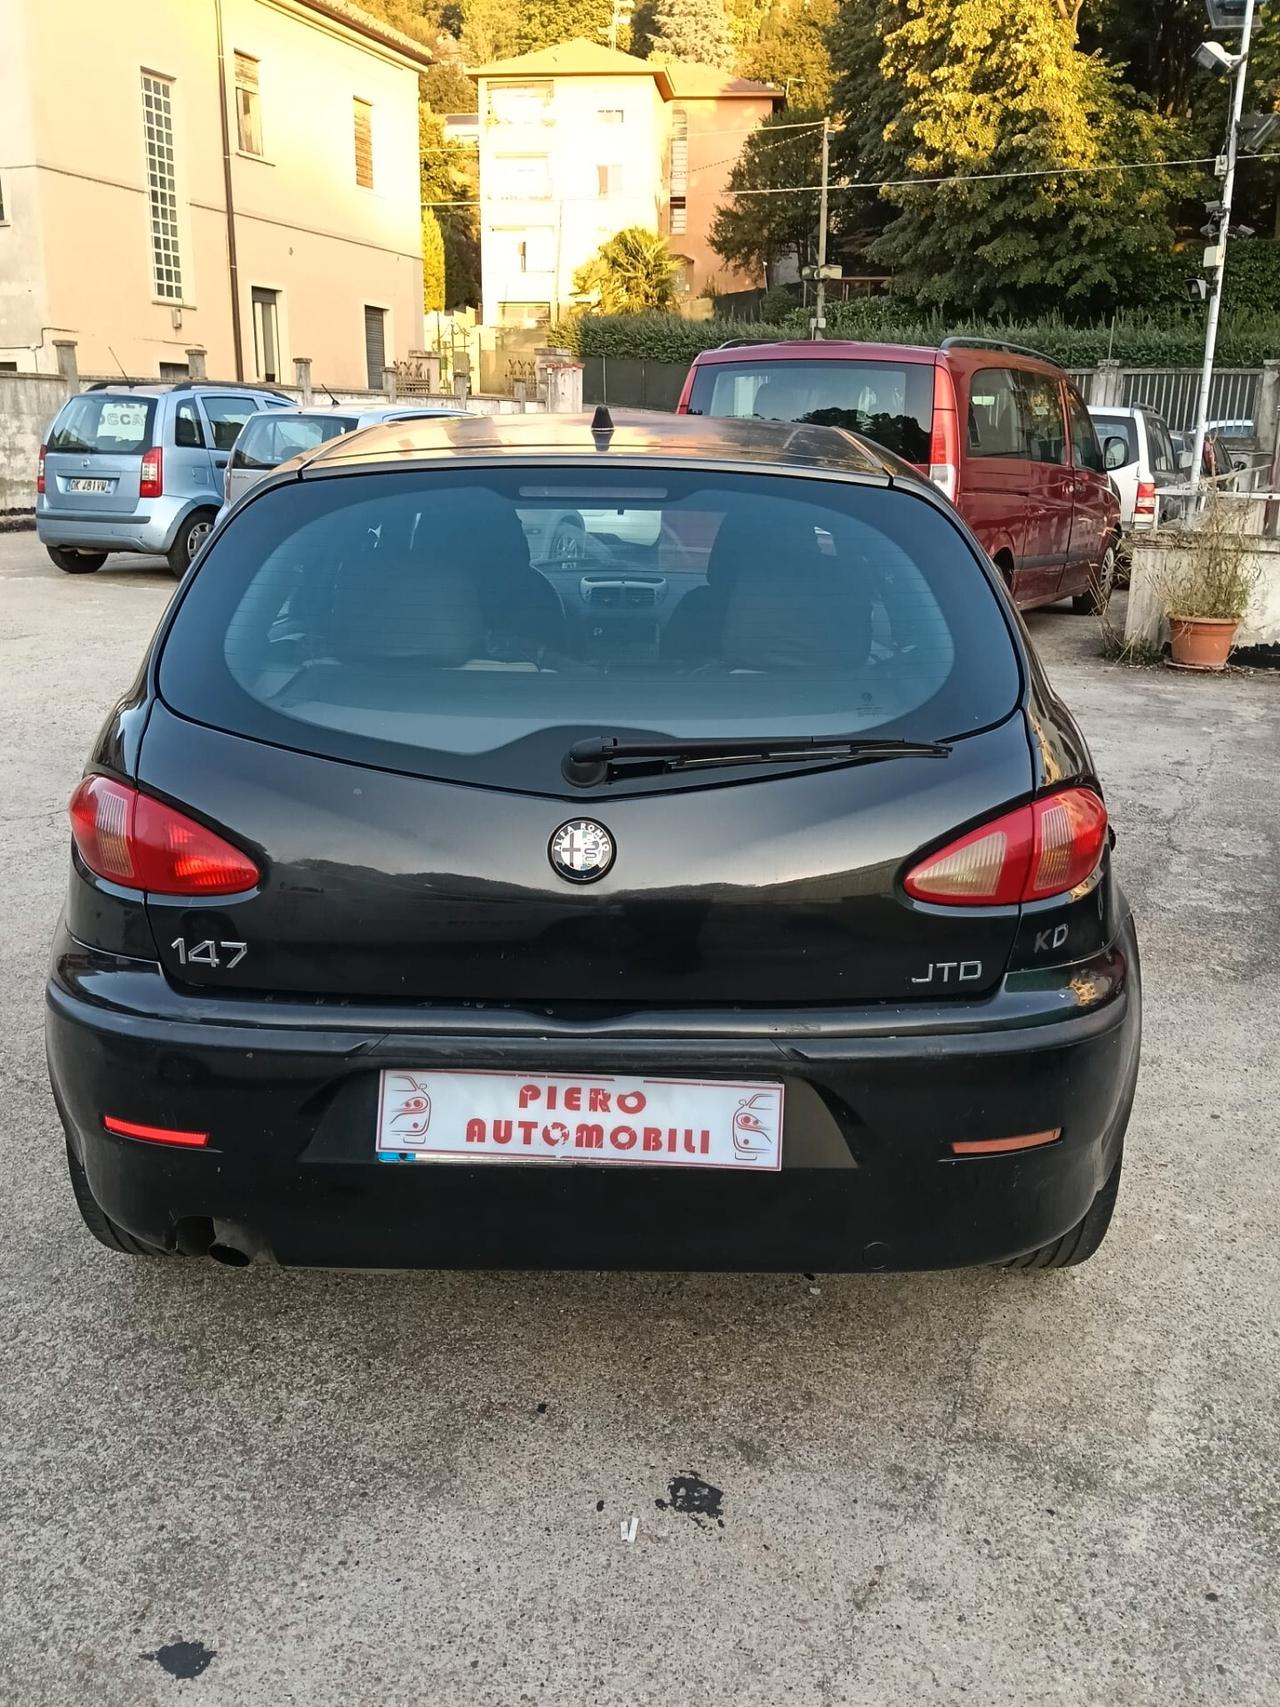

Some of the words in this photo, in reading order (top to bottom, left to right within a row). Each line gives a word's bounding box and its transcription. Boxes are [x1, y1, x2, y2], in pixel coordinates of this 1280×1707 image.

[554, 826, 575, 851] ALFA
[580, 823, 609, 851] ROMEO
[171, 937, 247, 968] 147
[911, 960, 982, 983] JTD
[518, 1084, 647, 1114] PIERO
[465, 1117, 711, 1154] AUTOMOBILI
